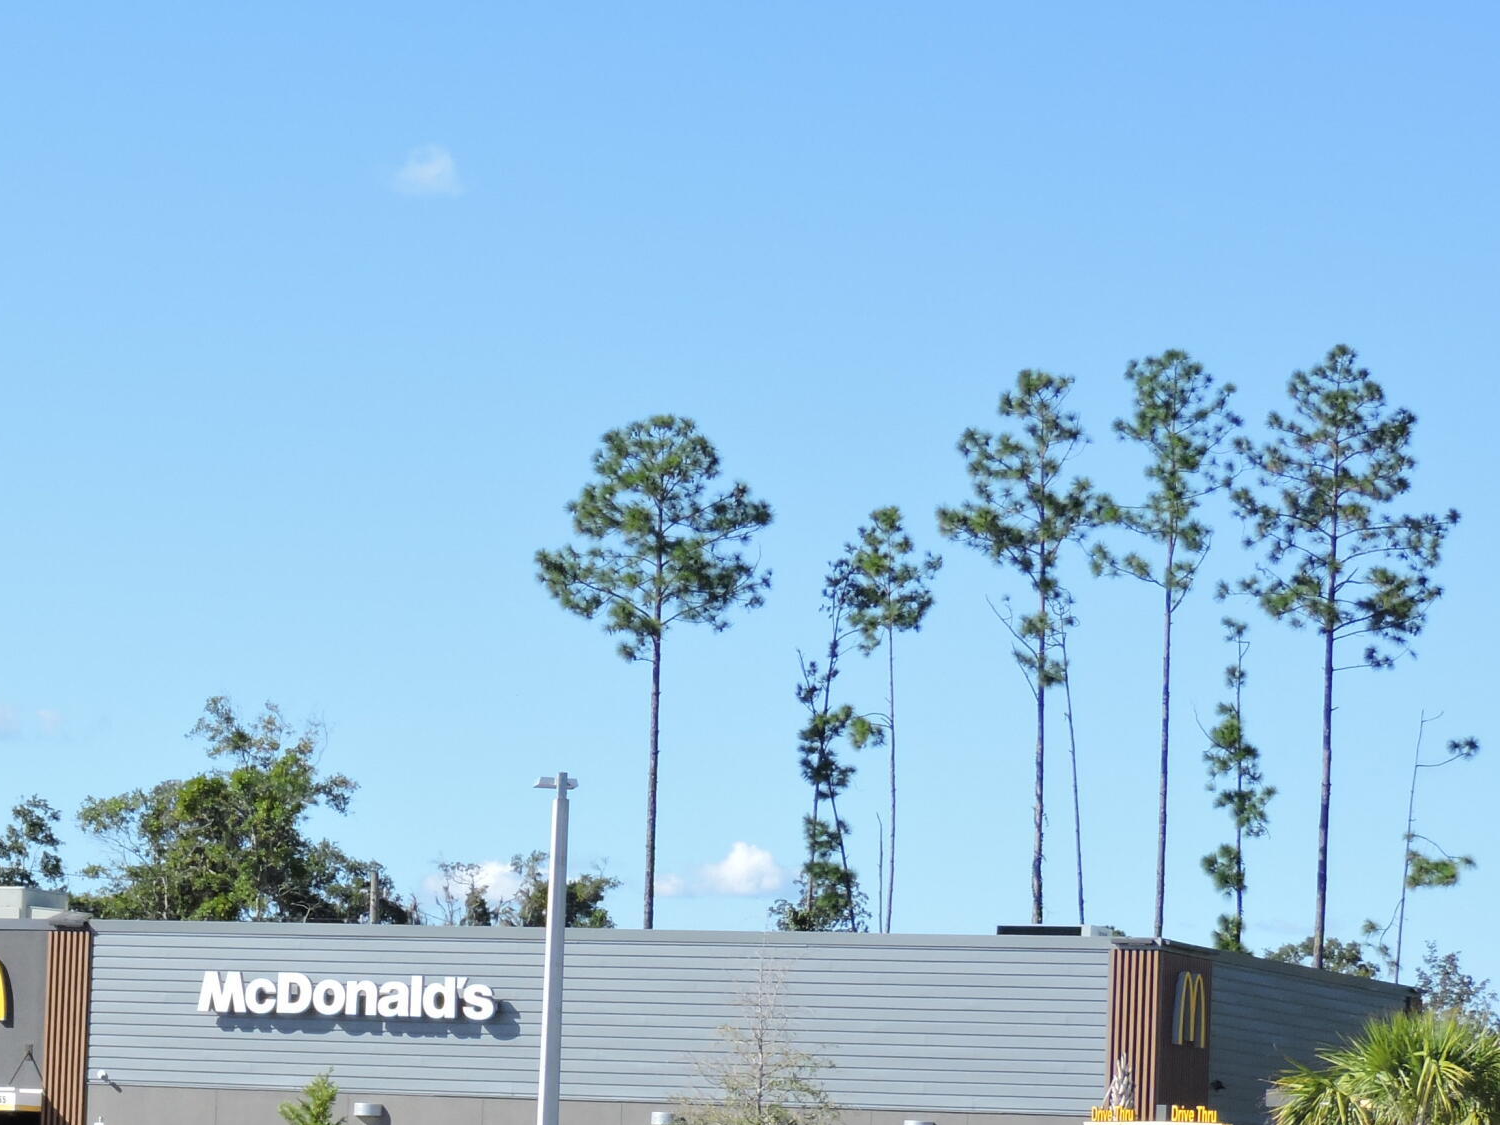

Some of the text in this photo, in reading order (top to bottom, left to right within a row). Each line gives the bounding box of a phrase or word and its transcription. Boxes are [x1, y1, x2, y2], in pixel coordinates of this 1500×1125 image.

[196, 970, 497, 1021] McDonald's
[1091, 1105, 1135, 1122] Drive Thru
[1171, 1105, 1218, 1123] Drive Thru
